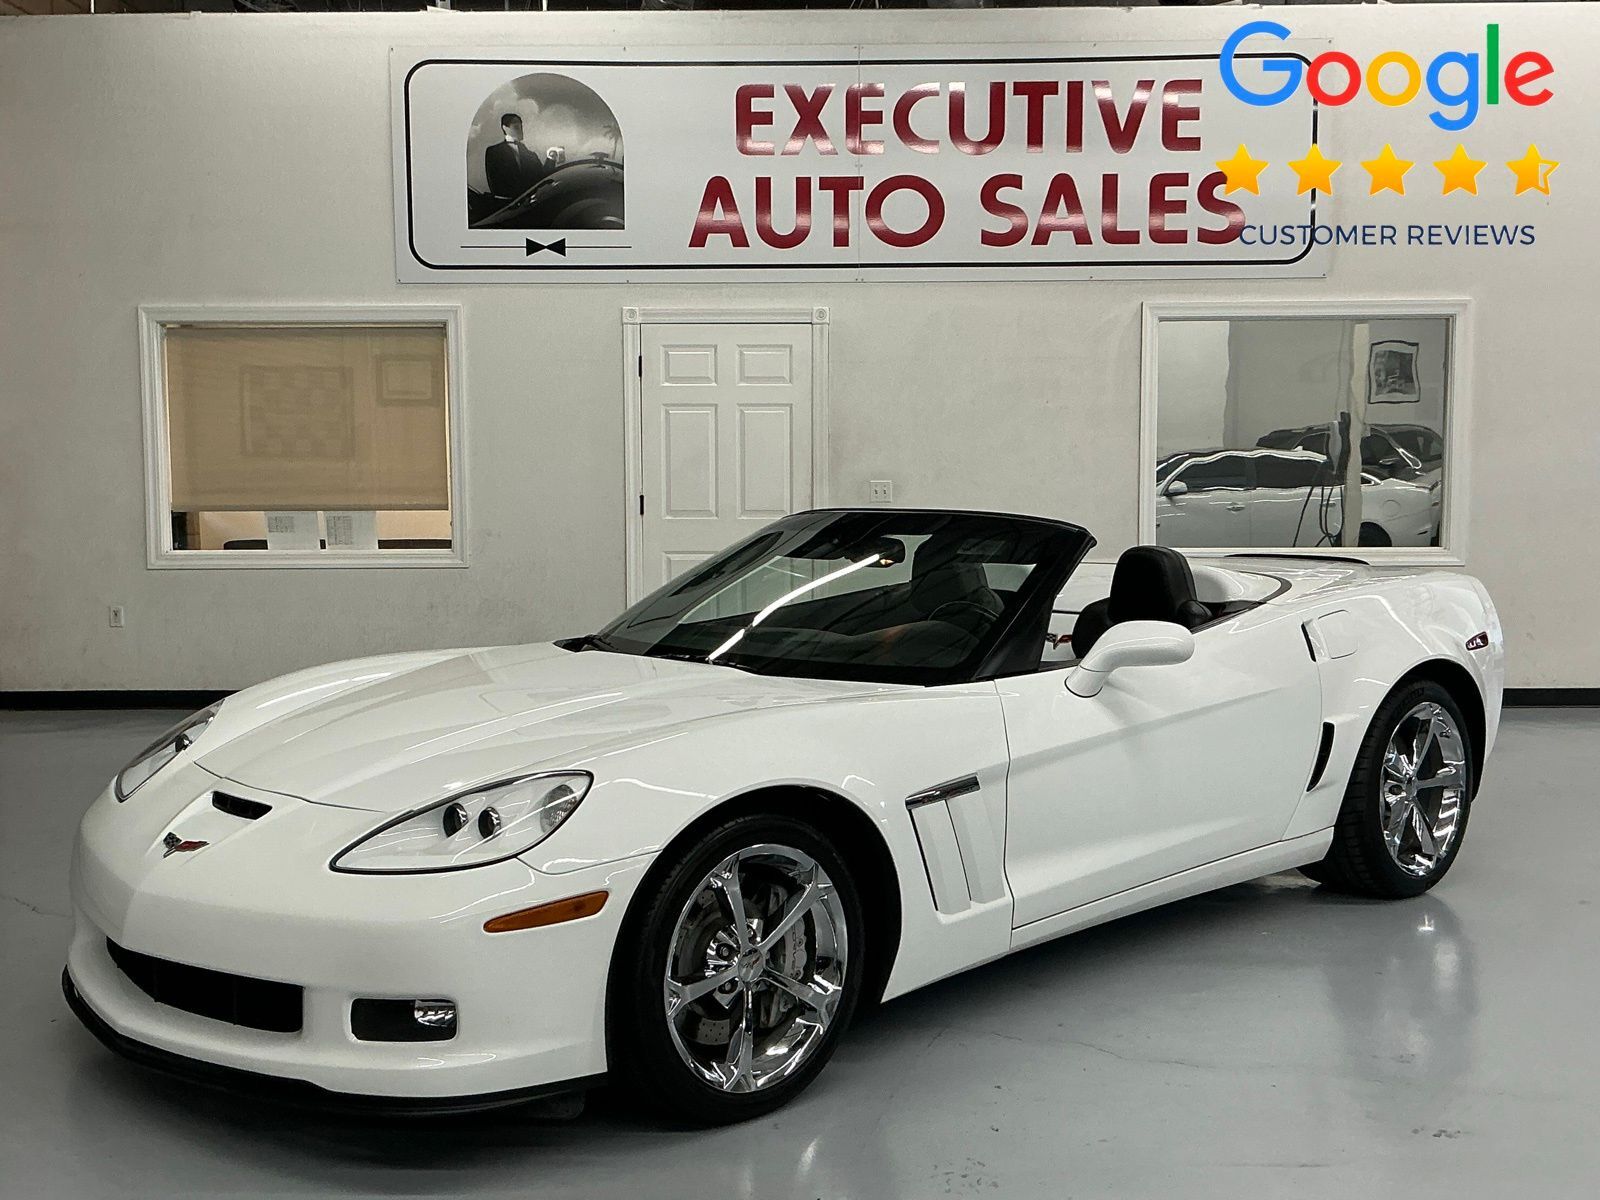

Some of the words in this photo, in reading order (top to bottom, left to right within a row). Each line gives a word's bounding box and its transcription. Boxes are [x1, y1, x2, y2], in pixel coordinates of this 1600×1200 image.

[735, 79, 1203, 156] EXECUTIVE
[688, 174, 946, 249] AUTO
[980, 171, 1246, 248] SALES
